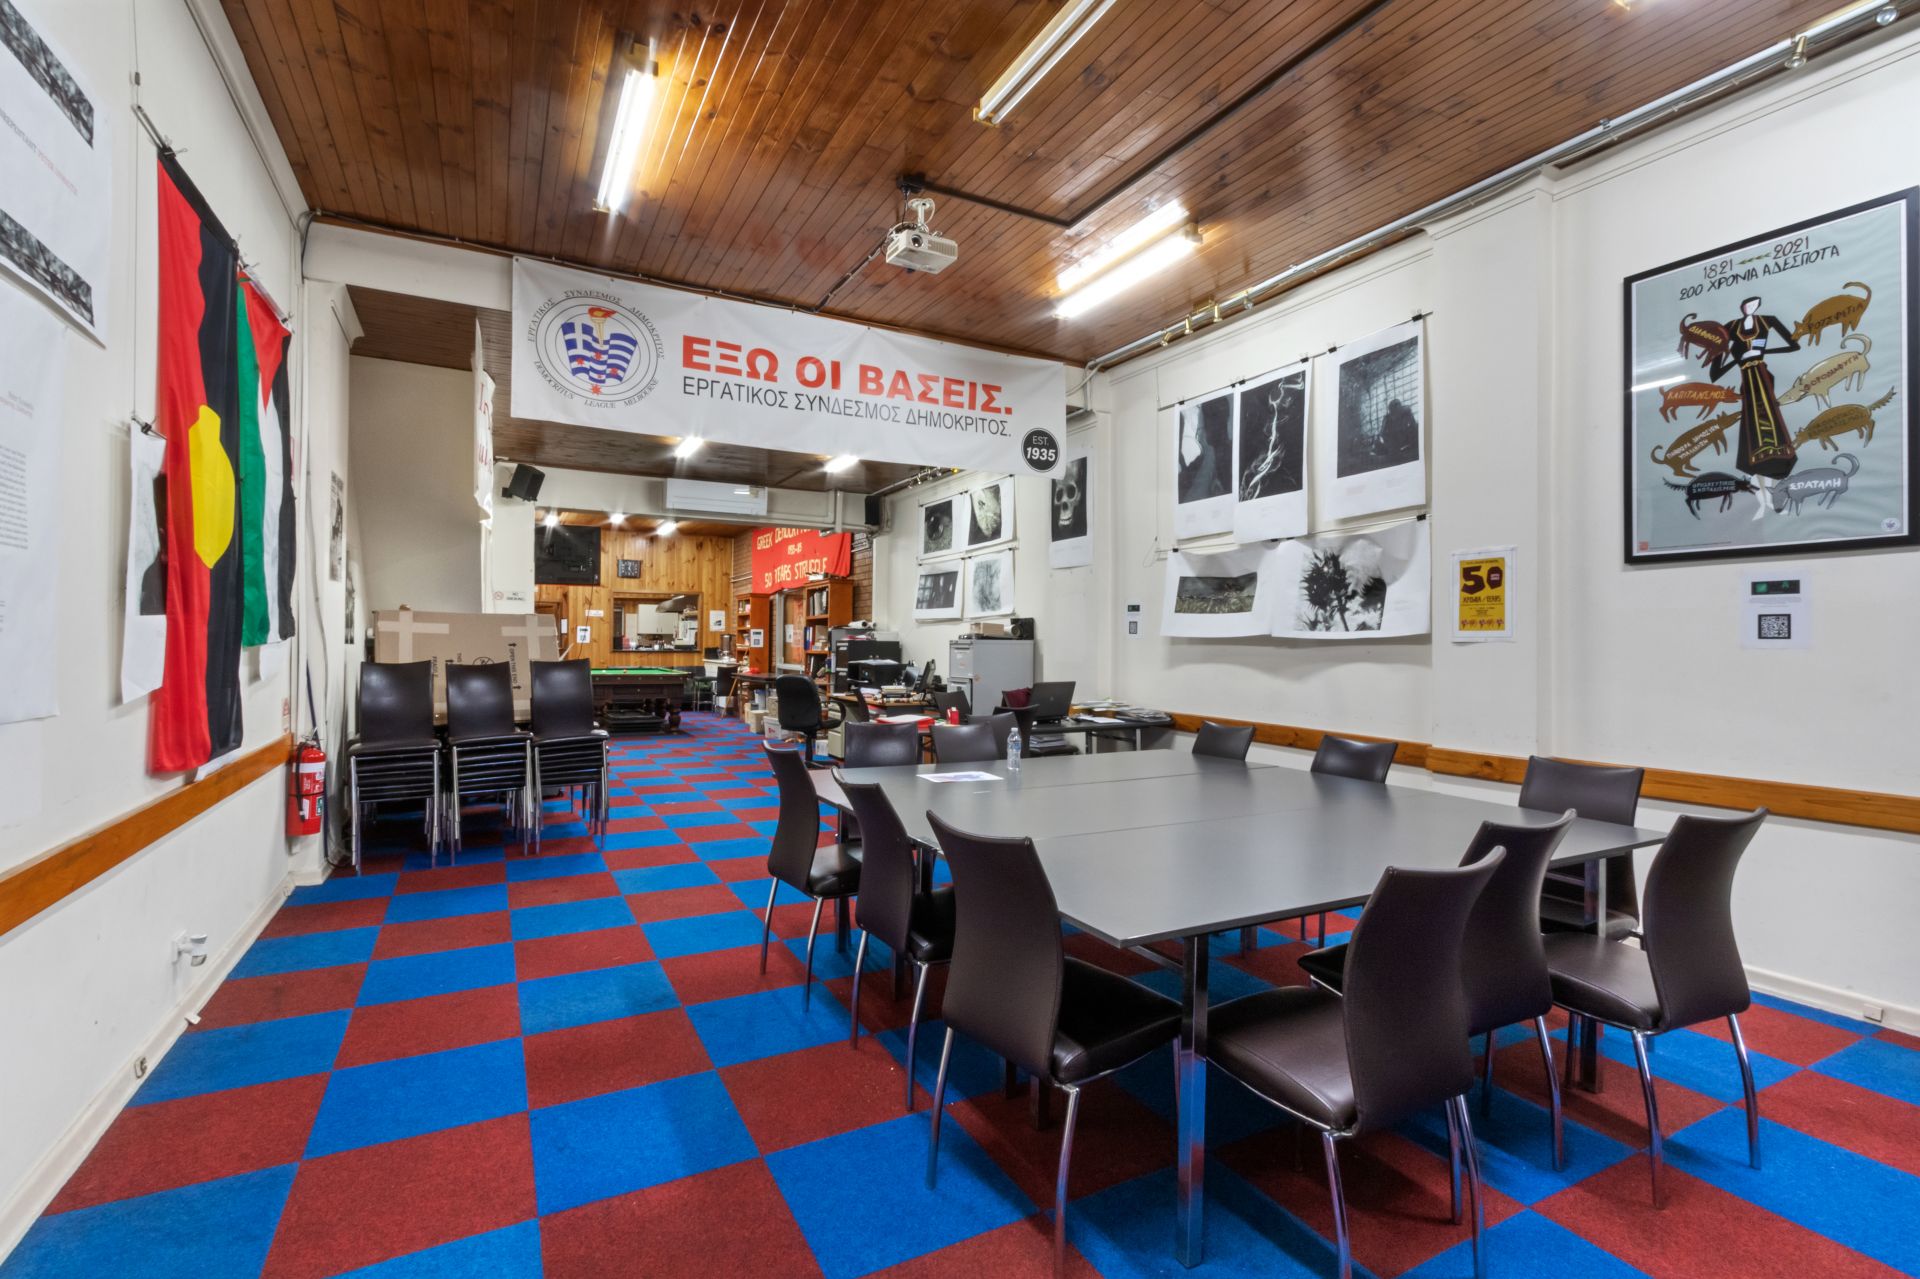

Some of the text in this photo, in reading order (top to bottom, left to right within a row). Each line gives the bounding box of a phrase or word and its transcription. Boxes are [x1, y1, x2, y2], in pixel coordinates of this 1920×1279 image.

[1679, 244, 1840, 300] 200 ΧΡΟΝΙΑ ΑΔΕΣΠΟΤΑ
[1703, 236, 1809, 280] 1821 2021
[528, 289, 665, 360] ΕΡΓΑΤΙΚΟΣ ΣΥΝΔΕΣΜΟΣ ΔΗΜΟΚΡΙΤΟΣ
[682, 334, 1013, 416] ΕΞΩ ΟΙ ΒΑΣΕΙΣ.
[583, 399, 617, 409] LEAGUE
[624, 378, 659, 408] MELBOURNE
[683, 375, 1013, 438] ΕΡΓΑΤΙΚΟΣ ΣΥΝΔΕΣΜΟΣ ΔΗΜΟΚΡΙΤΟΣ.
[1026, 446, 1056, 462] 1935
[1032, 435, 1050, 446] EST.
[756, 531, 774, 550] GREEK
[764, 572, 773, 588] 50
[774, 564, 791, 583] YEARS
[1461, 565, 1503, 595] 50
